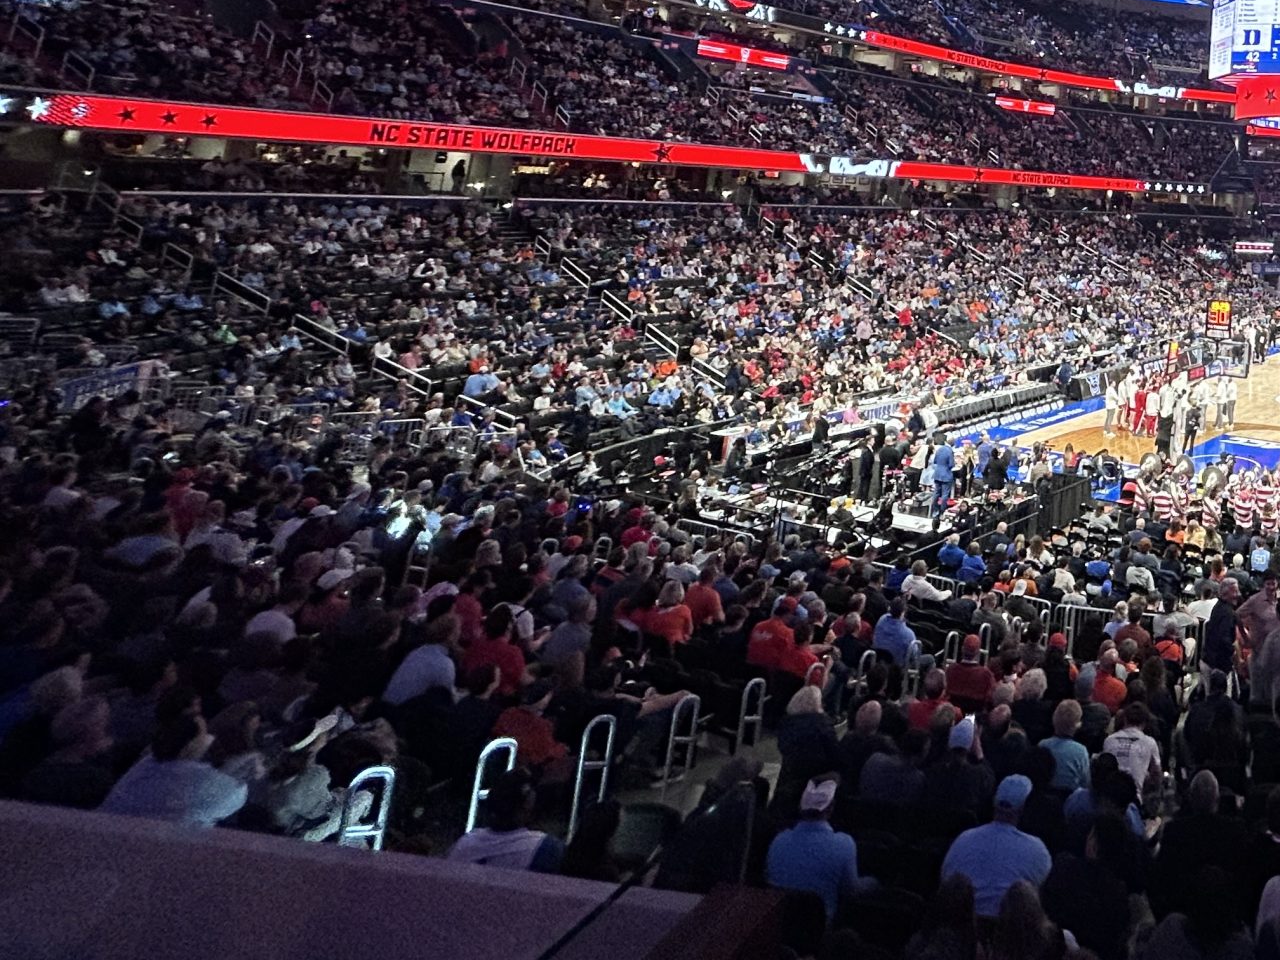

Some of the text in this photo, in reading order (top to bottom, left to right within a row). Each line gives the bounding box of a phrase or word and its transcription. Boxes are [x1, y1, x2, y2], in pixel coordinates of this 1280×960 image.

[947, 51, 1007, 72] NC STATE WOLFPACK
[1246, 52, 1260, 62] 42
[371, 124, 576, 154] NC STATE WOLFPACK
[1013, 173, 1071, 185] NC STATE WOLFPACK
